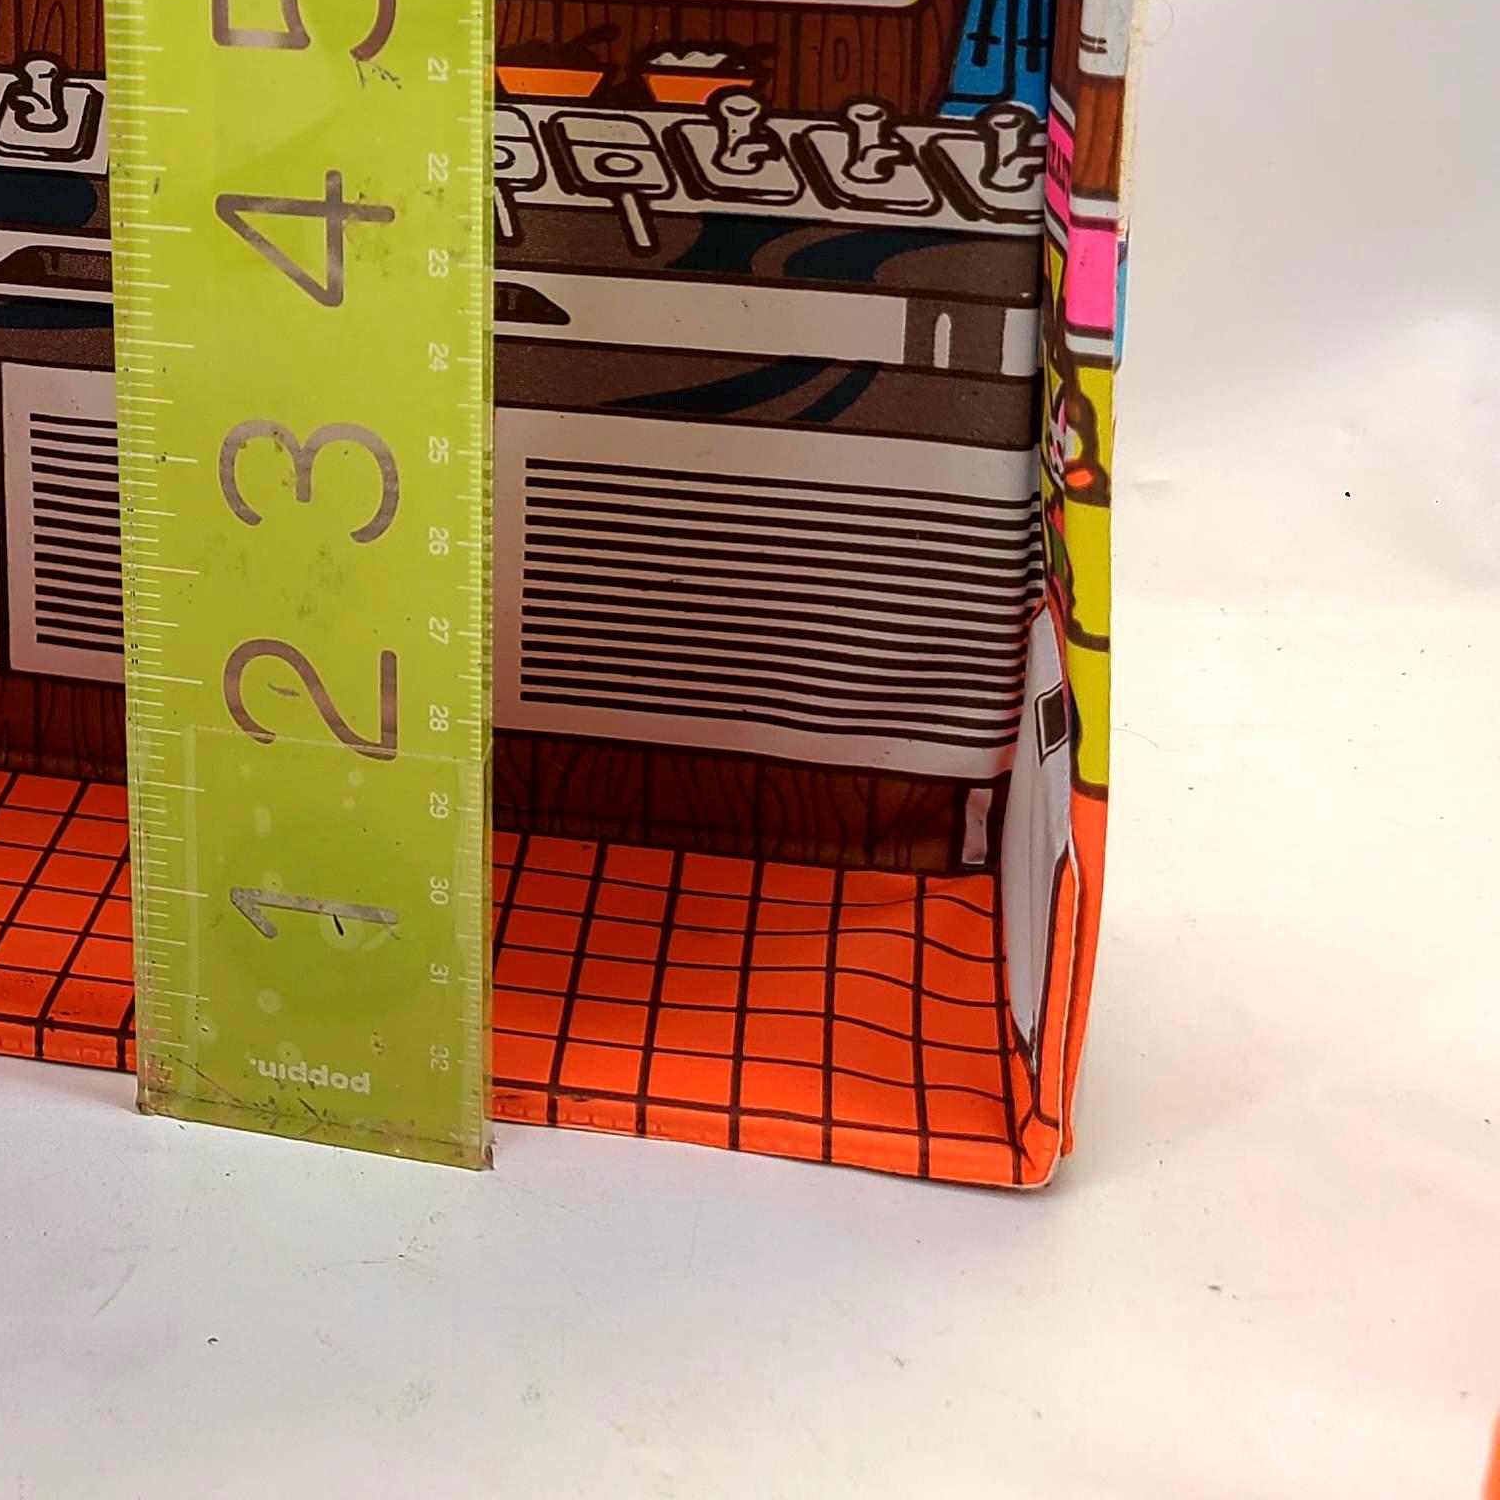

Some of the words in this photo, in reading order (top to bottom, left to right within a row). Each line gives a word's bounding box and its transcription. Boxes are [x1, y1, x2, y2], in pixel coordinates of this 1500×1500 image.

[427, 58, 450, 82] 21
[427, 153, 450, 183] 22
[215, 170, 396, 307] 4
[428, 249, 450, 277] 23
[428, 343, 450, 371] 24
[428, 436, 450, 464] 25
[218, 419, 399, 543] 3
[428, 526, 450, 555] 26
[428, 618, 450, 645] 27
[223, 638, 398, 761] 2
[428, 705, 450, 732] 28
[429, 792, 450, 818] 29
[429, 877, 450, 905] 30
[229, 886, 399, 938] 1
[429, 964, 450, 986] 31
[430, 1046, 450, 1071] 32
[249, 1058, 371, 1094] poppin.
